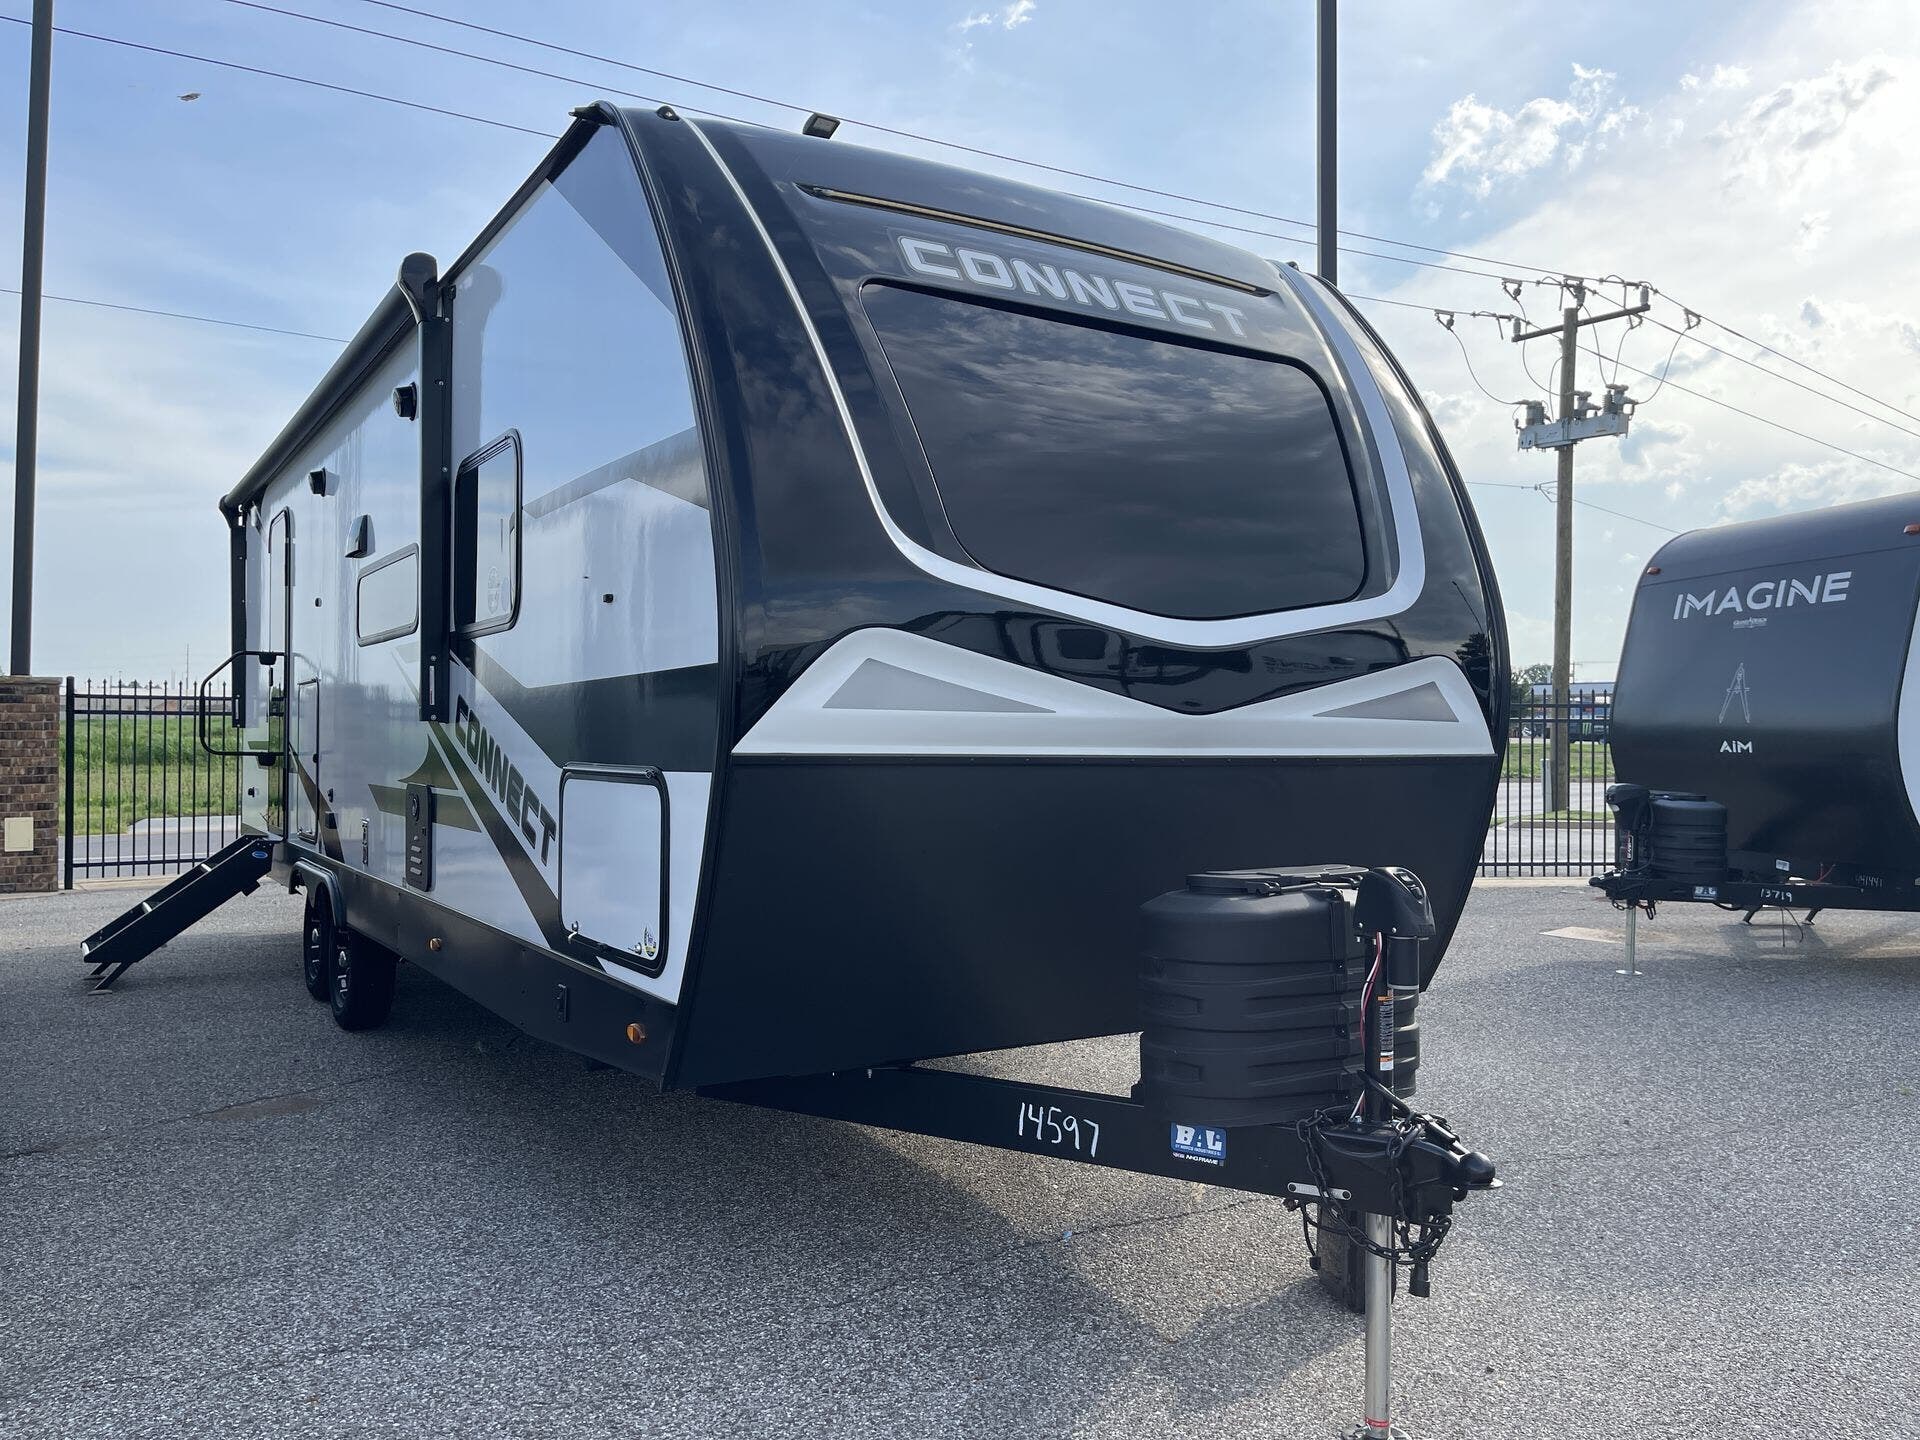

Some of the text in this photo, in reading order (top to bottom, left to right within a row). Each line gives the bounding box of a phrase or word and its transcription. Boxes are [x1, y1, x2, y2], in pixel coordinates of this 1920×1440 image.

[898, 235, 1246, 338] CONNECT
[1673, 571, 1853, 620] IMAGINE
[455, 693, 558, 868] CONNECT
[1760, 888, 1793, 903] 13719
[1018, 1102, 1100, 1158] 14597
[1175, 1124, 1223, 1152] BAL
